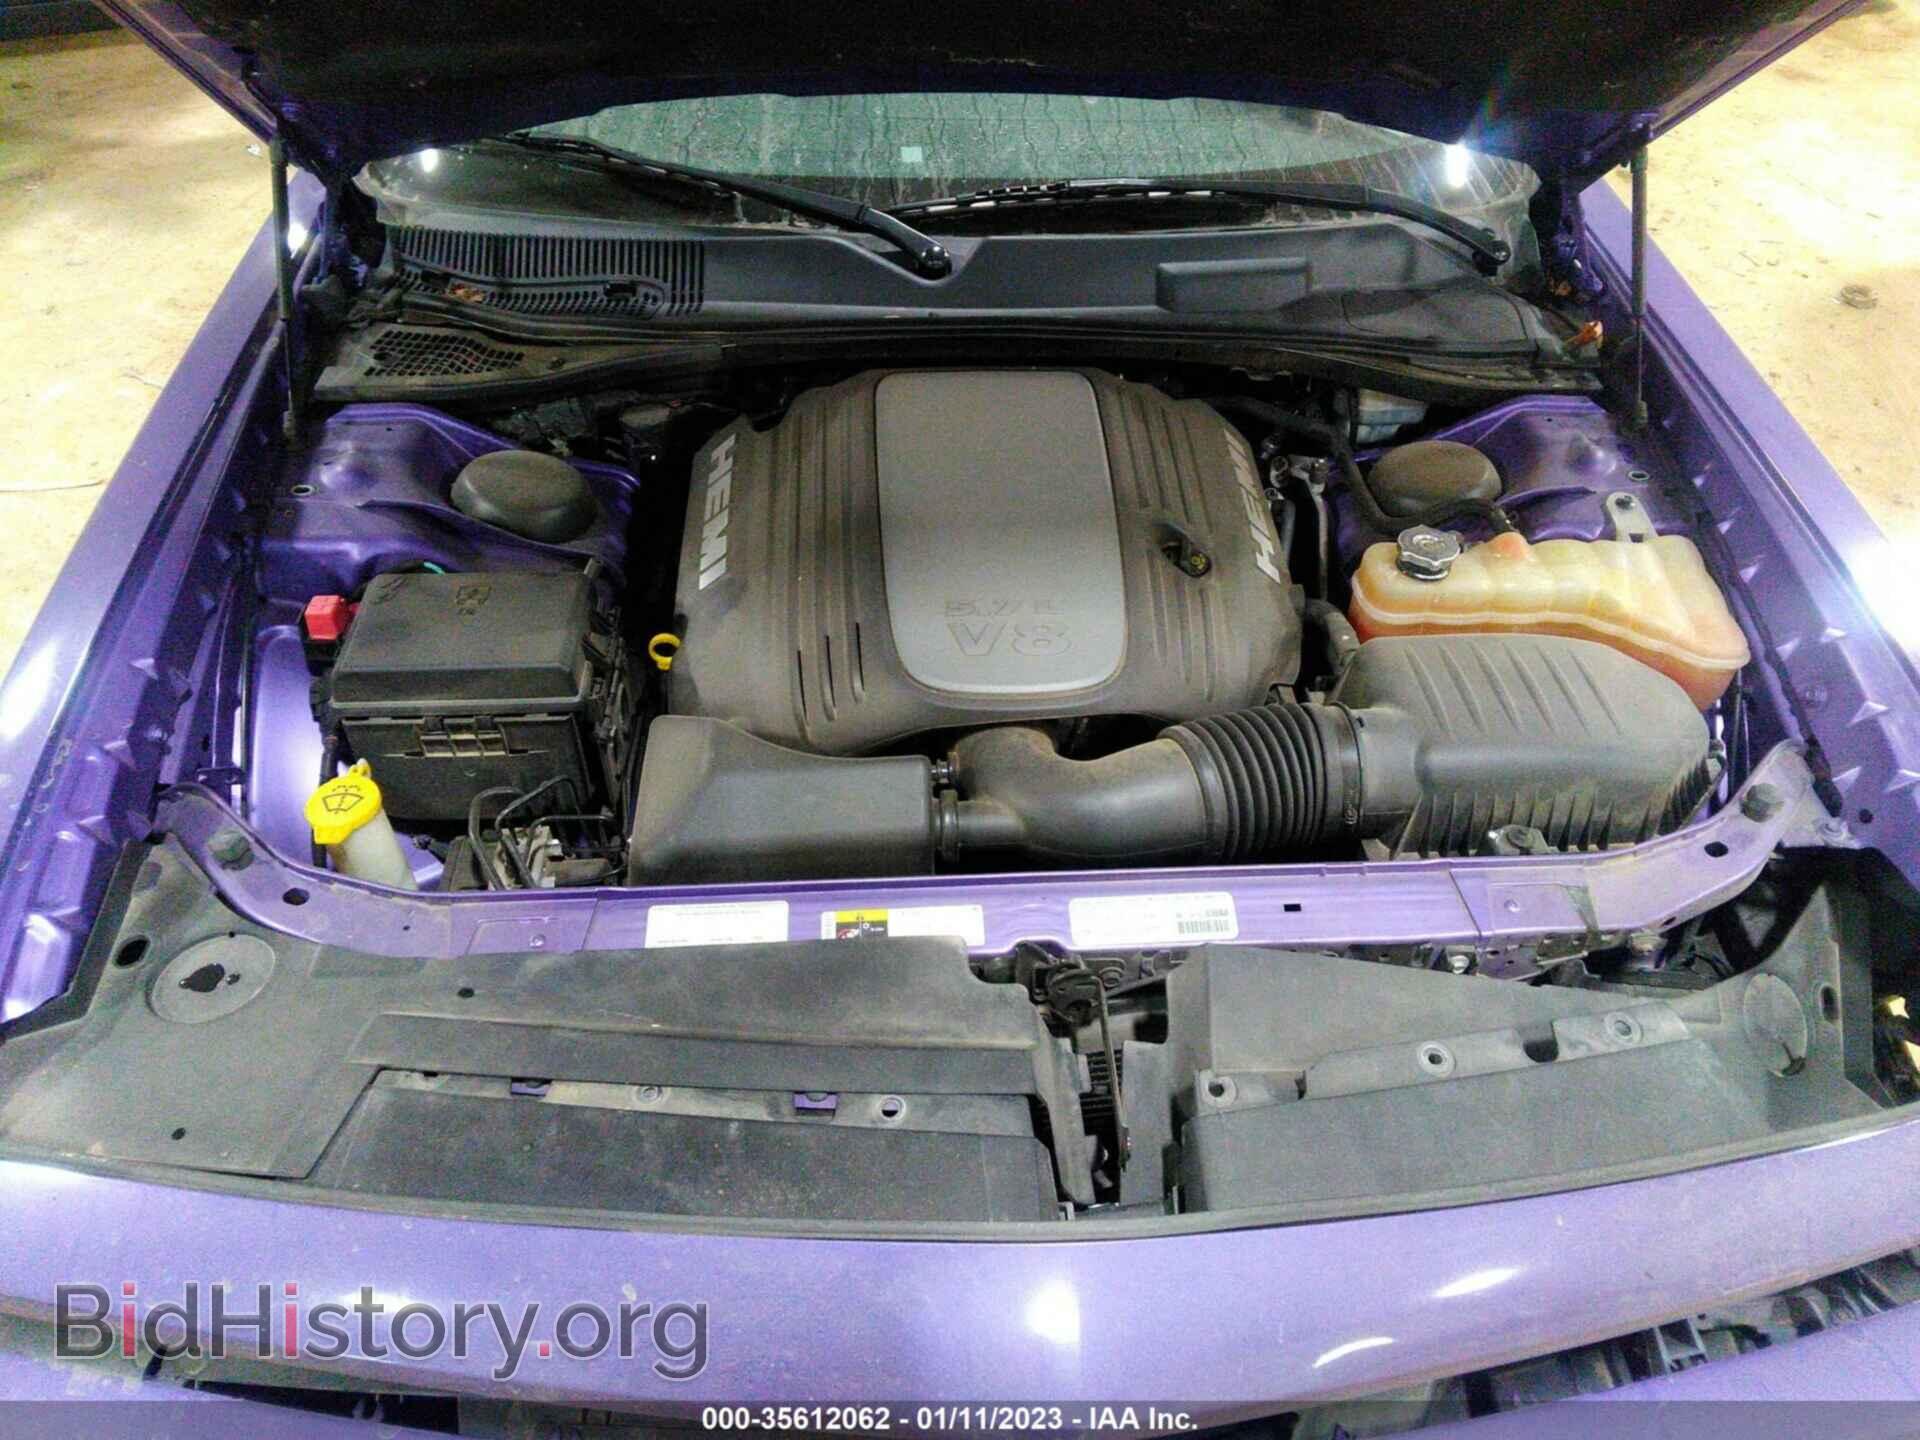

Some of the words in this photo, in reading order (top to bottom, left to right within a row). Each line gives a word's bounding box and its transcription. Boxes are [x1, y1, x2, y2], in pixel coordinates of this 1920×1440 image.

[698, 433, 737, 591] HEMI
[1223, 428, 1281, 585] HEMI
[945, 622, 1073, 657] V8
